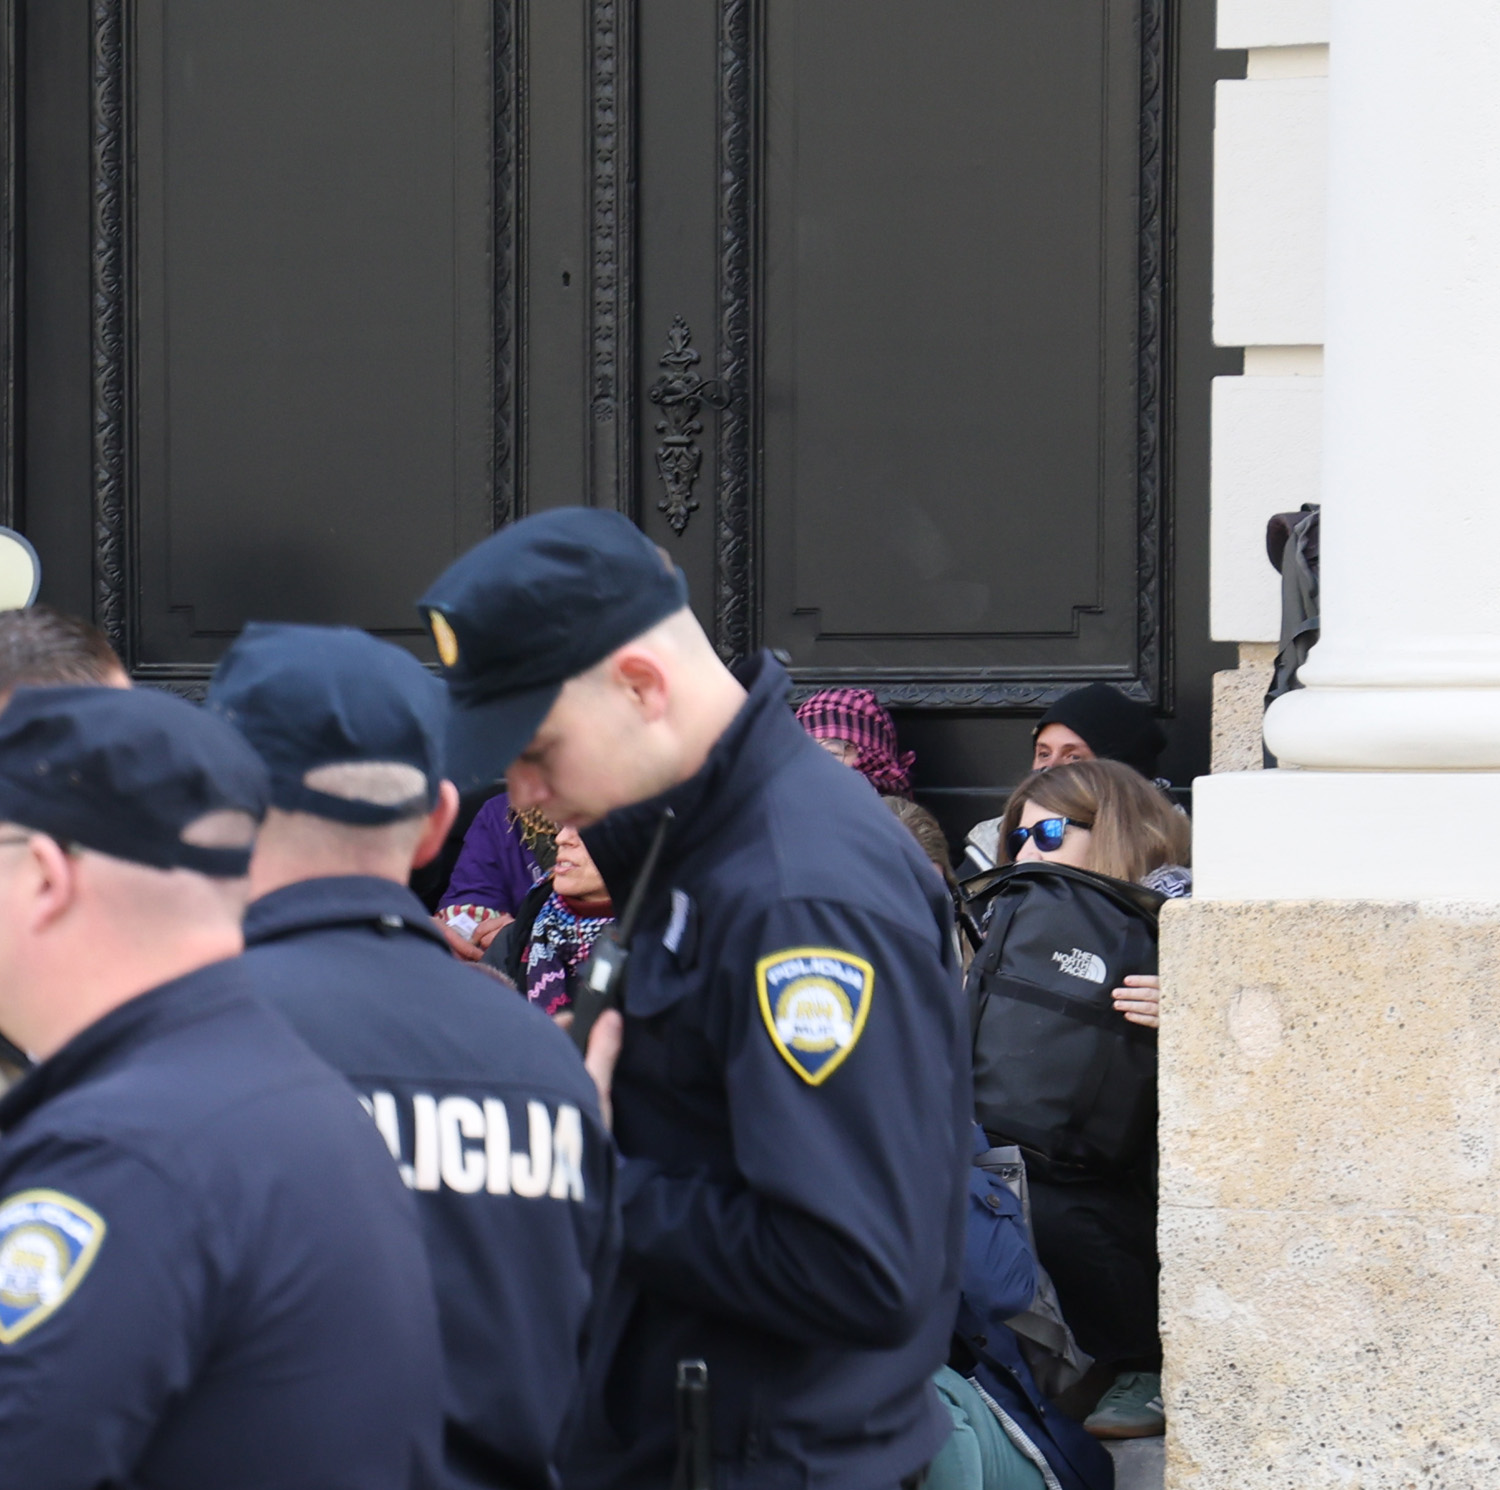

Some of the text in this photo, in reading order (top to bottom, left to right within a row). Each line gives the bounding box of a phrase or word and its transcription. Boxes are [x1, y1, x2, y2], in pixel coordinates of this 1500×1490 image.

[1051, 951, 1090, 971] NORTH
[1070, 947, 1093, 961] THE
[1058, 961, 1087, 978] FACE
[357, 1091, 586, 1202] LICIJA
